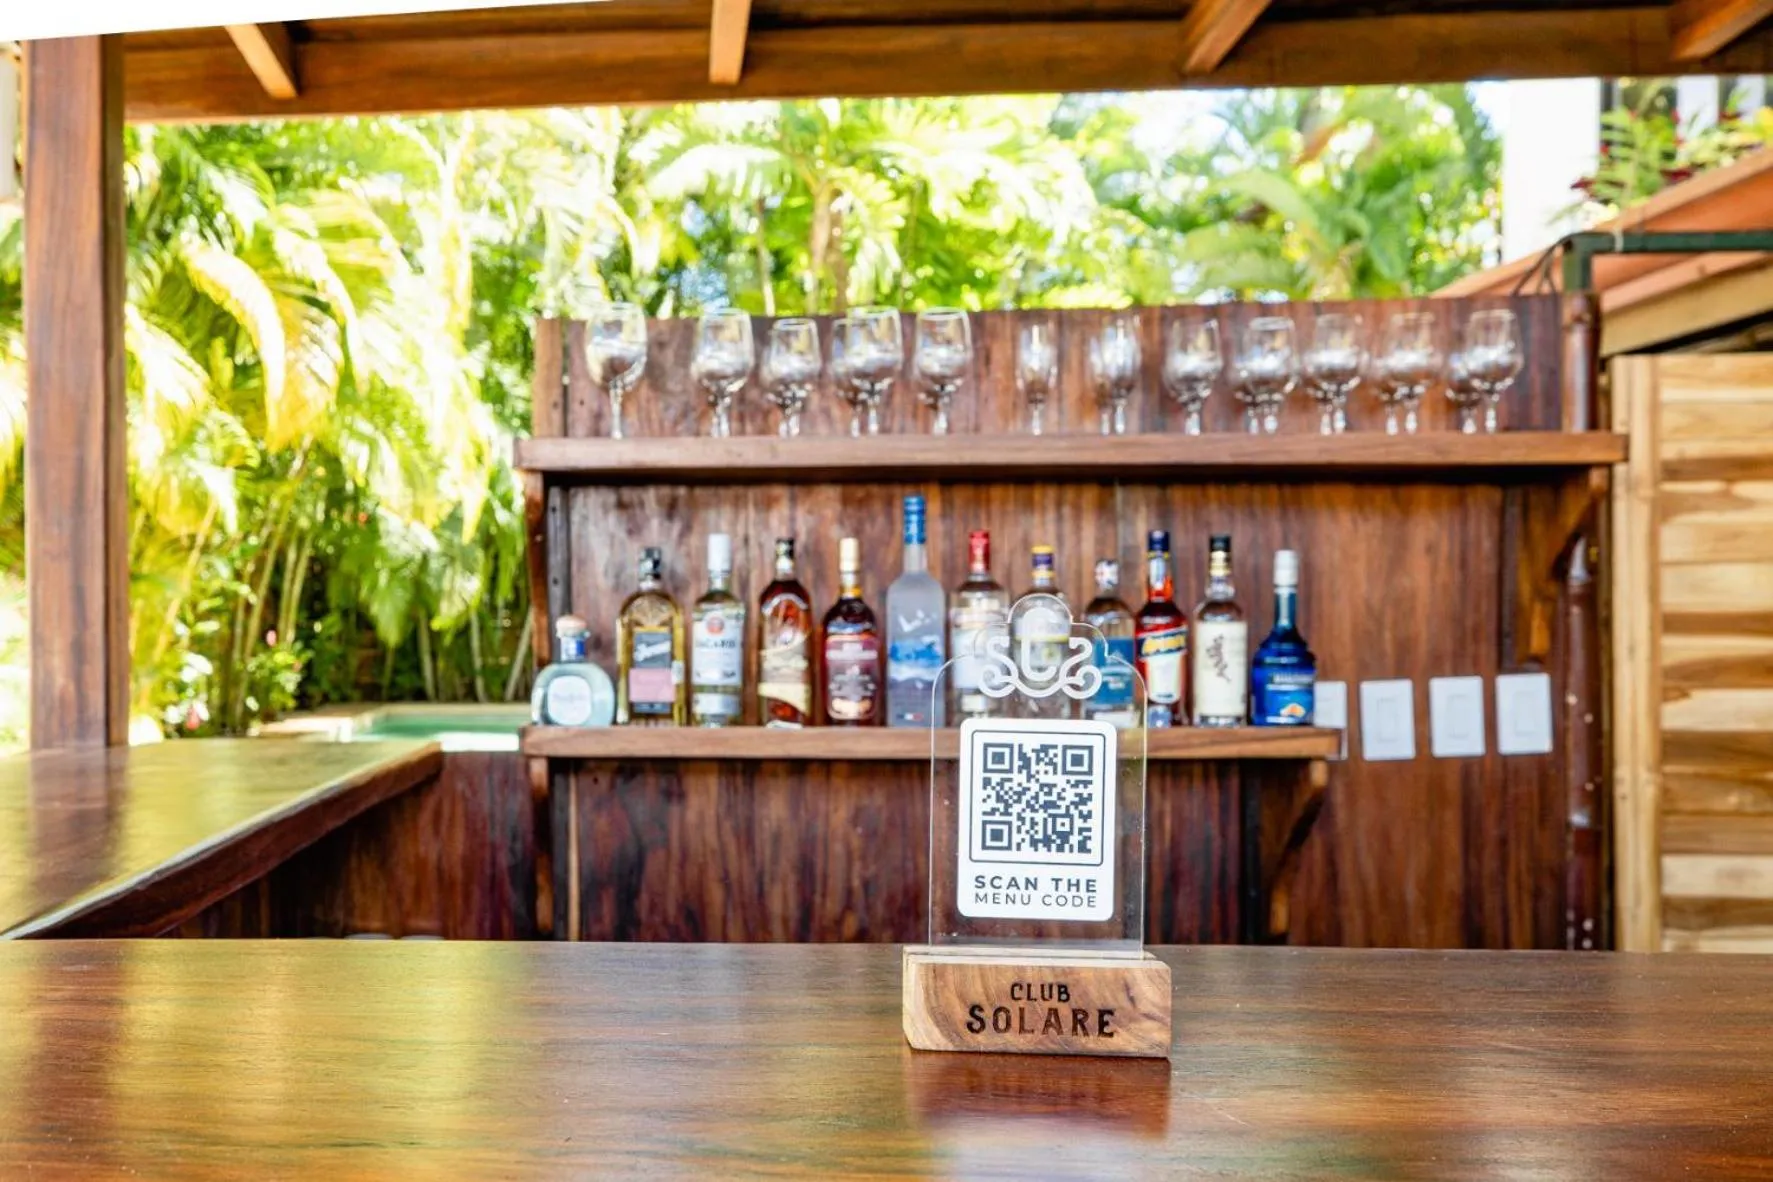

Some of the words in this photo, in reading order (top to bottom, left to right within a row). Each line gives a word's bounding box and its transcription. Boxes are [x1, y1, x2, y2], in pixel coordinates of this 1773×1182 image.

[974, 875, 1039, 891] SCAN
[1051, 877, 1097, 893] THE
[974, 893, 1032, 906] MENU
[1042, 894, 1097, 908] CODE
[1010, 982, 1071, 1003] CLUB
[966, 1004, 1116, 1038] SOLARE
